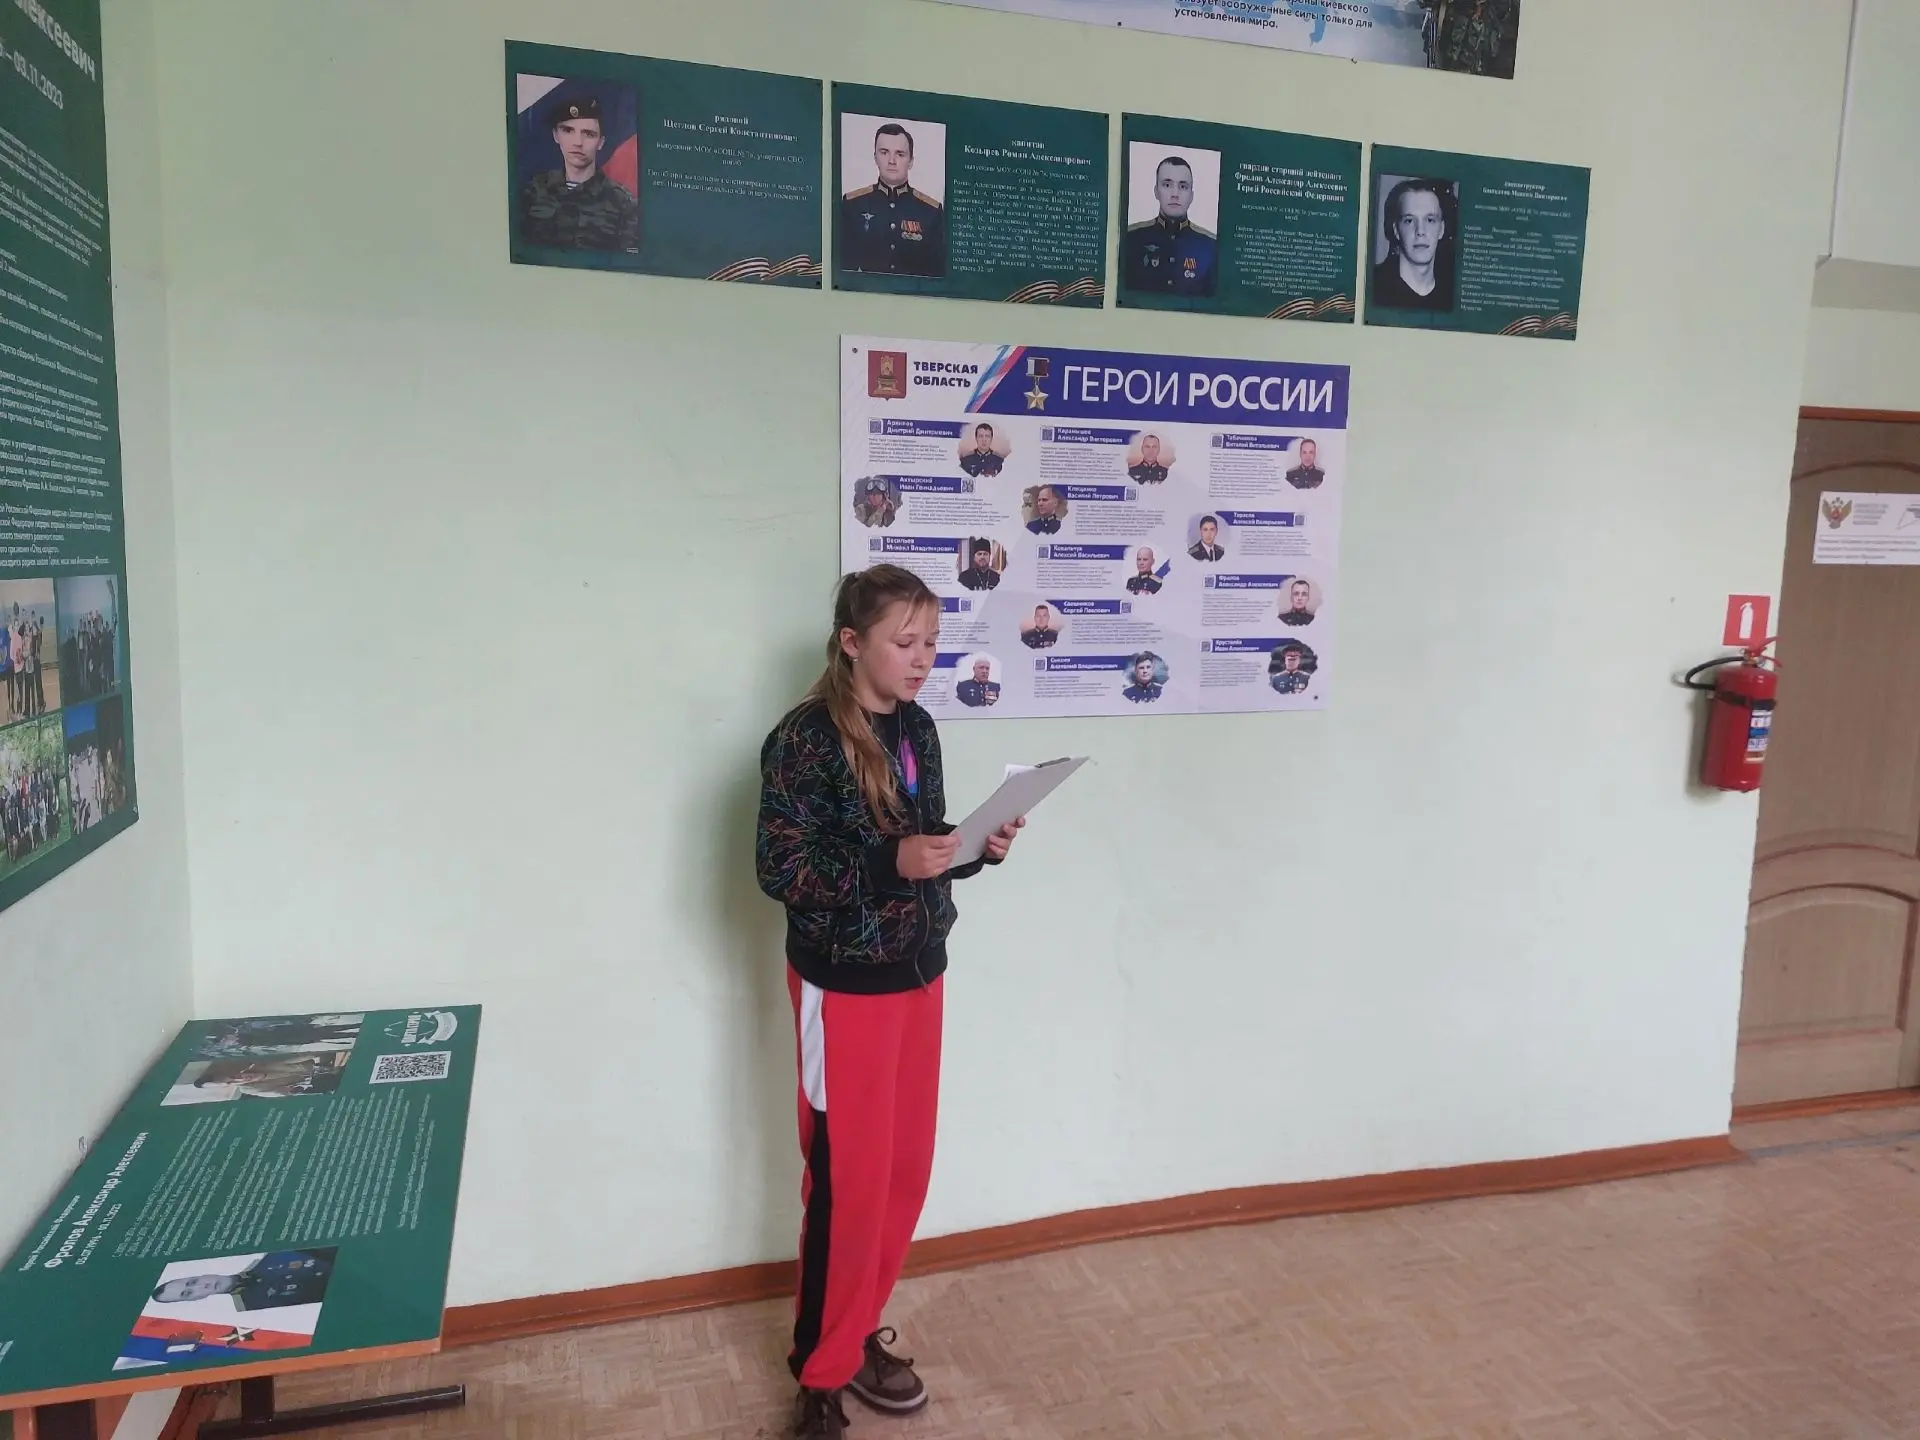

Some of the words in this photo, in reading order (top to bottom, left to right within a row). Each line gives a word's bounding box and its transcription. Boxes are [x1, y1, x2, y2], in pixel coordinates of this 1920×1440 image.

[1221, 1, 1292, 16] вооруженные
[1295, 10, 1318, 20] силы
[1322, 14, 1354, 26] только
[1356, 20, 1373, 29] для
[1320, 0, 1369, 13] киевского
[1174, 8, 1246, 24] установления
[1248, 17, 1278, 29] мира.
[14, 0, 96, 82] лексеевич
[699, 124, 728, 134] Сергей
[913, 361, 979, 375] ТВЕРСКАЯ
[913, 375, 972, 389] ОБЛАСТЬ
[1062, 365, 1181, 406] ГЕРОИ
[1187, 376, 1335, 414] РОССИИ
[43, 1227, 86, 1268] Фролов
[72, 1178, 123, 1226] Александр
[107, 1131, 149, 1177] Алексеевич
